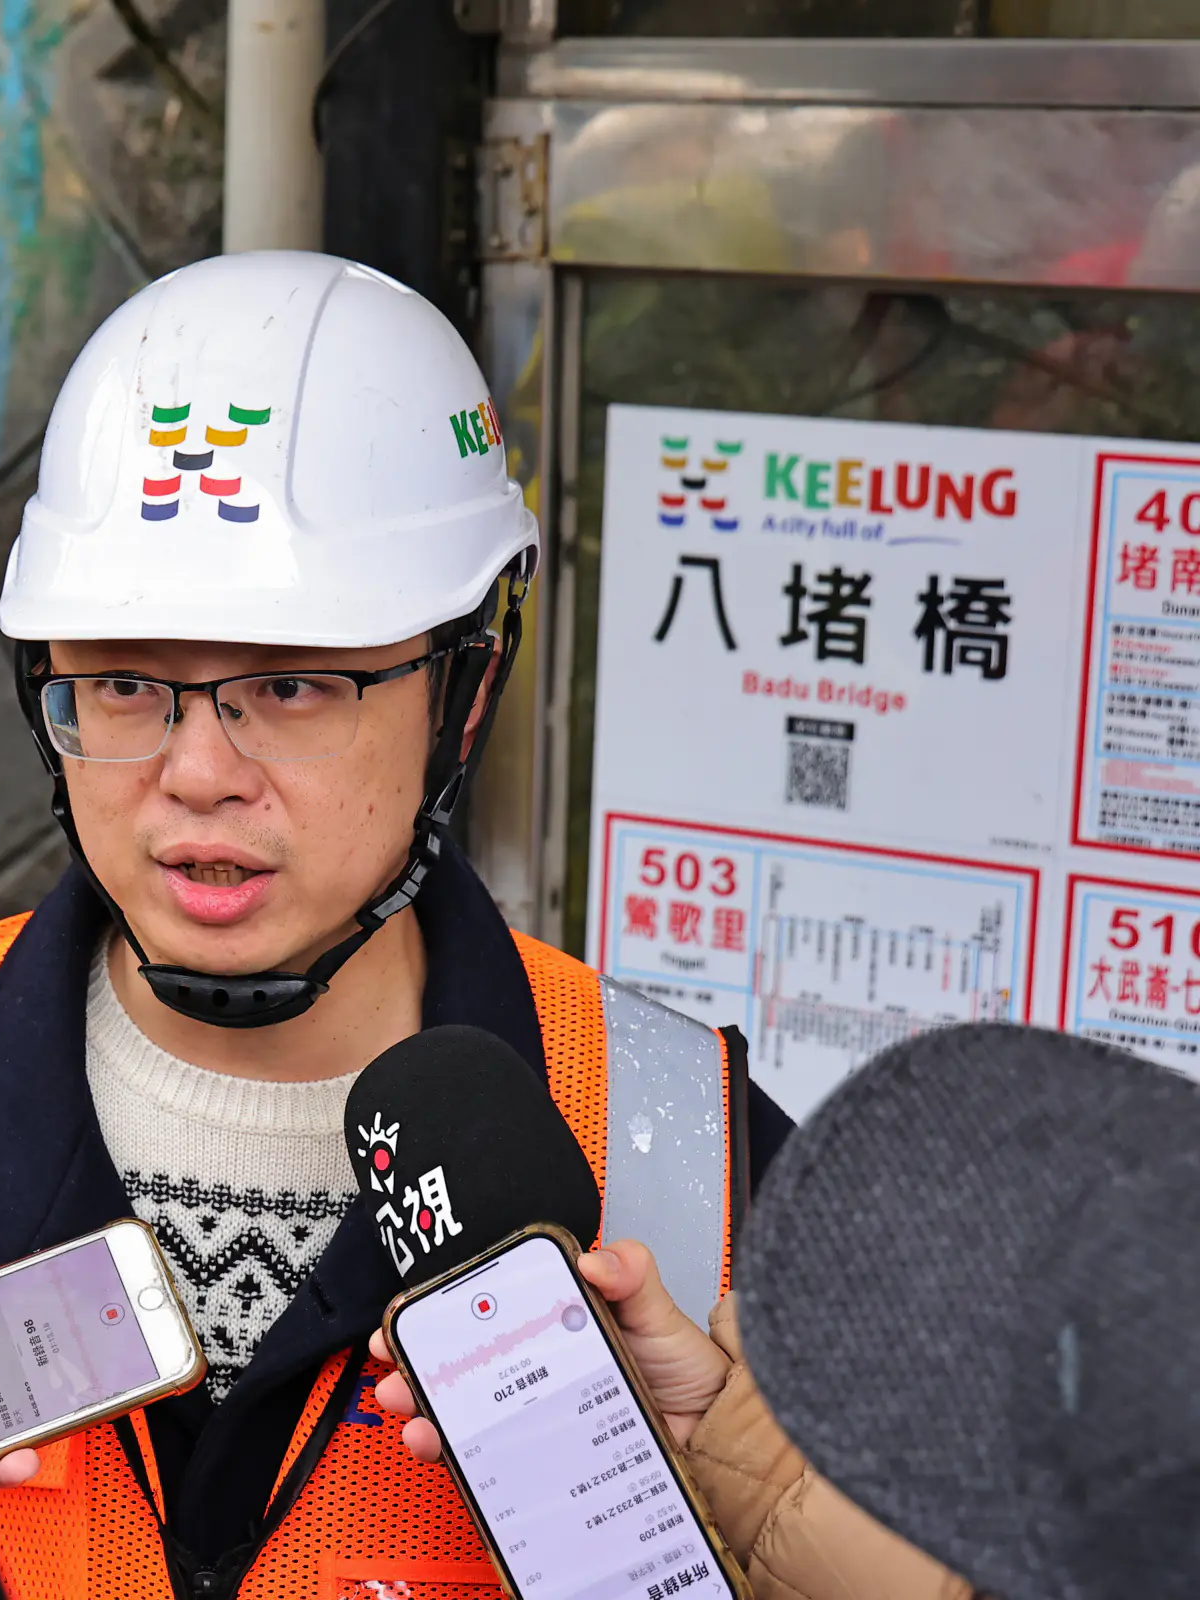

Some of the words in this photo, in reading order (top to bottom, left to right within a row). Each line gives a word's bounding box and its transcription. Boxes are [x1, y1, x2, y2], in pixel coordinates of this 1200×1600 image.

[449, 396, 502, 459] KEEL
[764, 452, 1018, 521] KEELUNG
[780, 517, 816, 541] city
[822, 517, 857, 539] full
[861, 520, 883, 541] of
[654, 554, 1012, 681] 八堵橋
[742, 670, 811, 701] Badu
[818, 677, 907, 714] Bridge
[640, 848, 737, 897] 503
[624, 893, 745, 953] 鶯歌里
[375, 1165, 464, 1278] 公視
[23, 1319, 36, 1335] 98
[29, 1335, 49, 1367] 新錄音
[515, 1365, 549, 1391] 新錄音
[494, 1384, 515, 1402] 210
[595, 1385, 620, 1405] 新錄音
[578, 1400, 594, 1415] 207
[592, 1431, 610, 1447] 208
[610, 1417, 637, 1437] 新錄音
[639, 1528, 658, 1542] 209
[658, 1513, 684, 1533] 新錄音
[647, 1560, 710, 1600] 所有錄音
